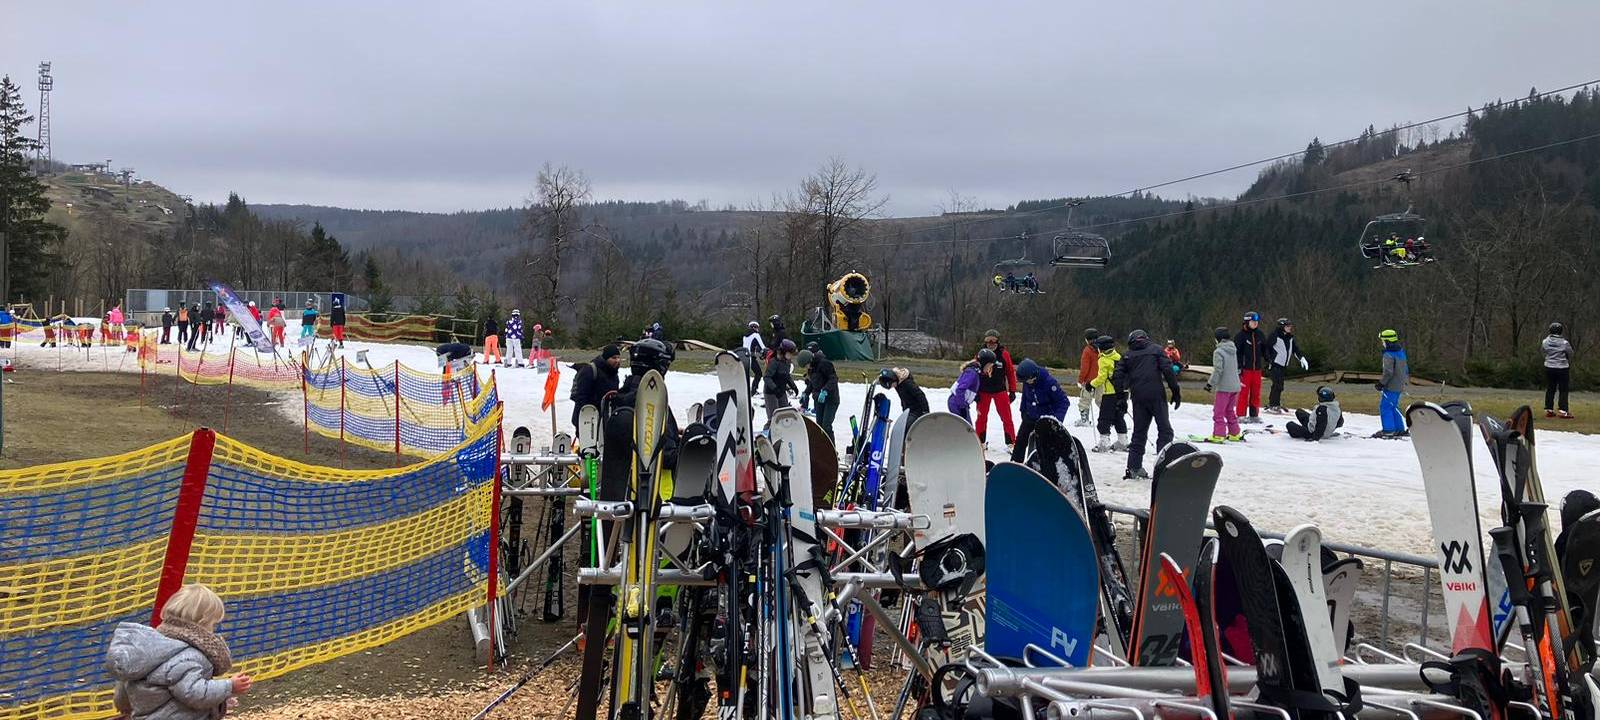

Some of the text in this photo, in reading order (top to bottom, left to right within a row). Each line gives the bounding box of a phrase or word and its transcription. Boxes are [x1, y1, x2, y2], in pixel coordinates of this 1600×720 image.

[515, 443, 523, 482] HED
[557, 444, 565, 482] HED
[1446, 582, 1476, 591] Völkl
[1151, 602, 1183, 612] Völk
